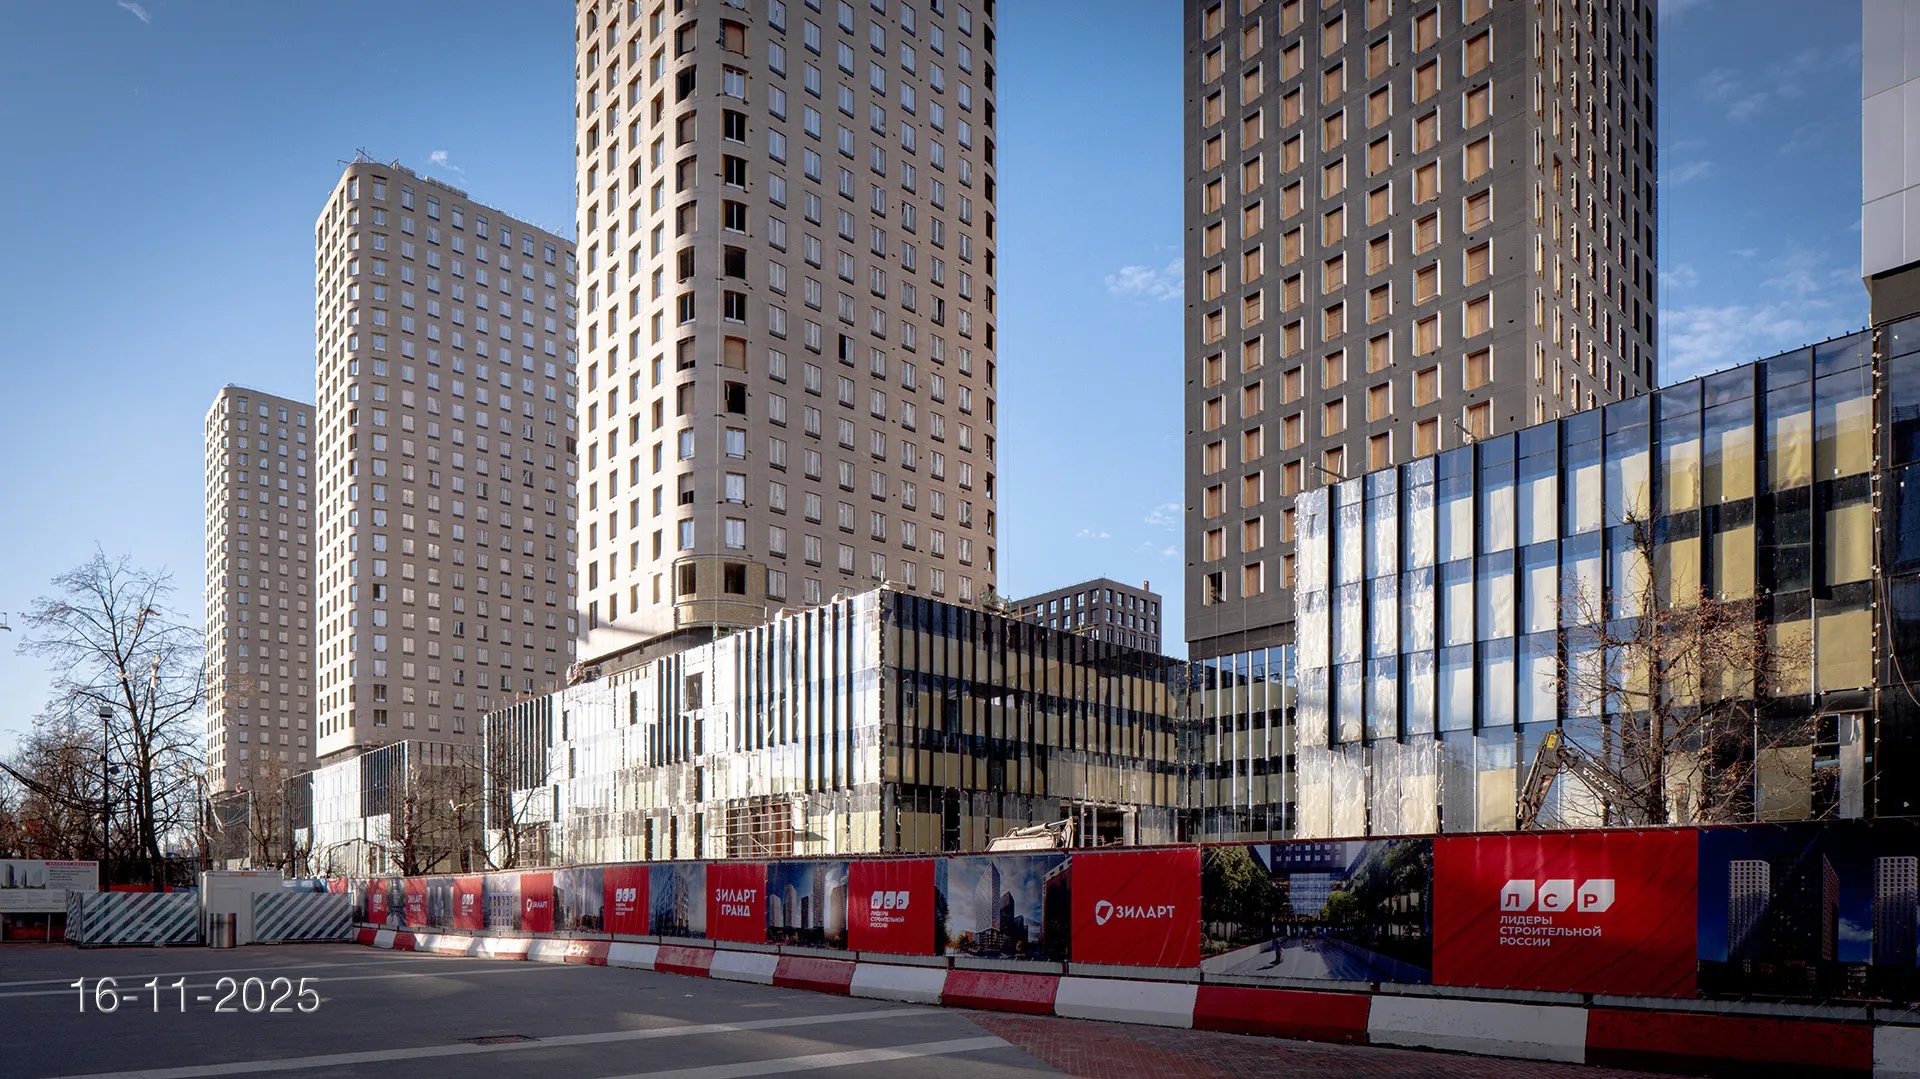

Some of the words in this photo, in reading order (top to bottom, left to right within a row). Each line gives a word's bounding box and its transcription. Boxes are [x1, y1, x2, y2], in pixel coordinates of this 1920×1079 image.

[715, 888, 757, 903] ЗИЛАРТ
[721, 904, 751, 917] ГРАНД
[1116, 905, 1176, 919] ЗИЛАРТ
[1500, 915, 1552, 925] ЛИДЕРЫ
[1500, 926, 1602, 937] СТРОИТЕЛЬНОЙ
[1500, 937, 1550, 946] РОССИИ
